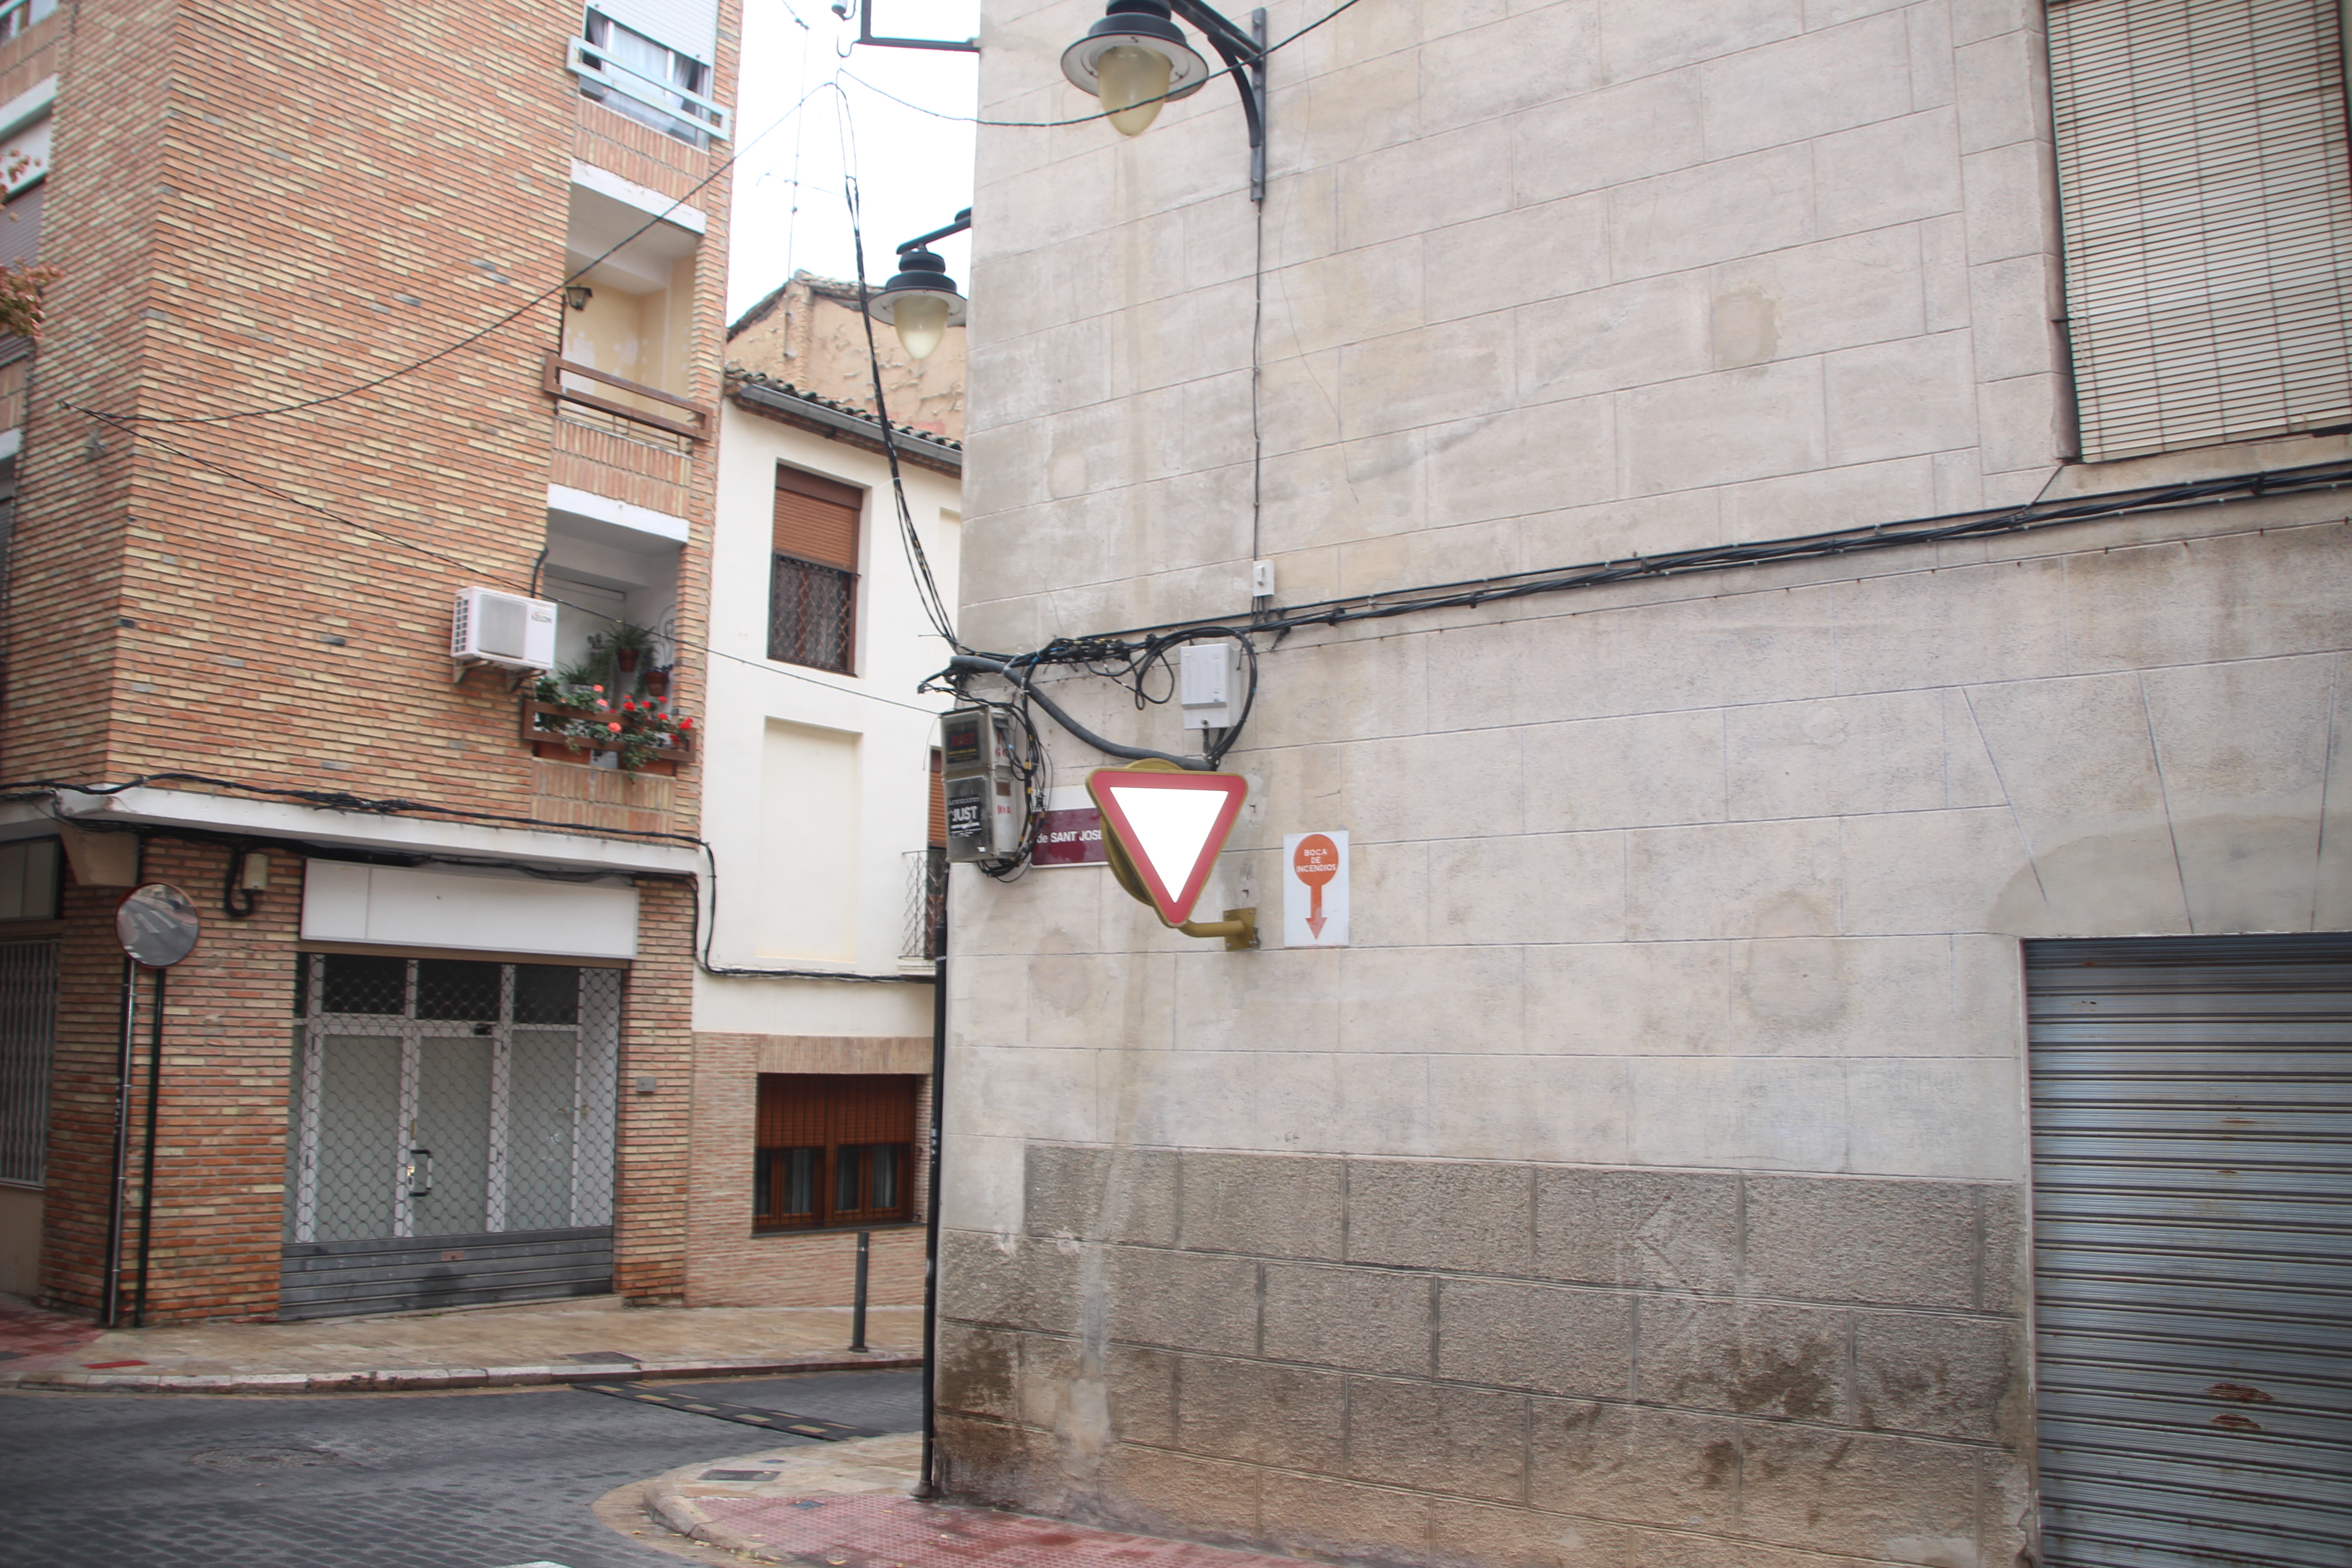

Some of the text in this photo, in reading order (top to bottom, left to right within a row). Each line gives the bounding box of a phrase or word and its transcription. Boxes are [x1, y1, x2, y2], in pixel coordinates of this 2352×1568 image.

[950, 732, 975, 747] JUST
[952, 805, 977, 821] JUST
[1036, 833, 1048, 843] de
[1050, 831, 1078, 843] SANT
[1303, 848, 1328, 857] BOCA
[1296, 863, 1337, 872] INCENDIOS
